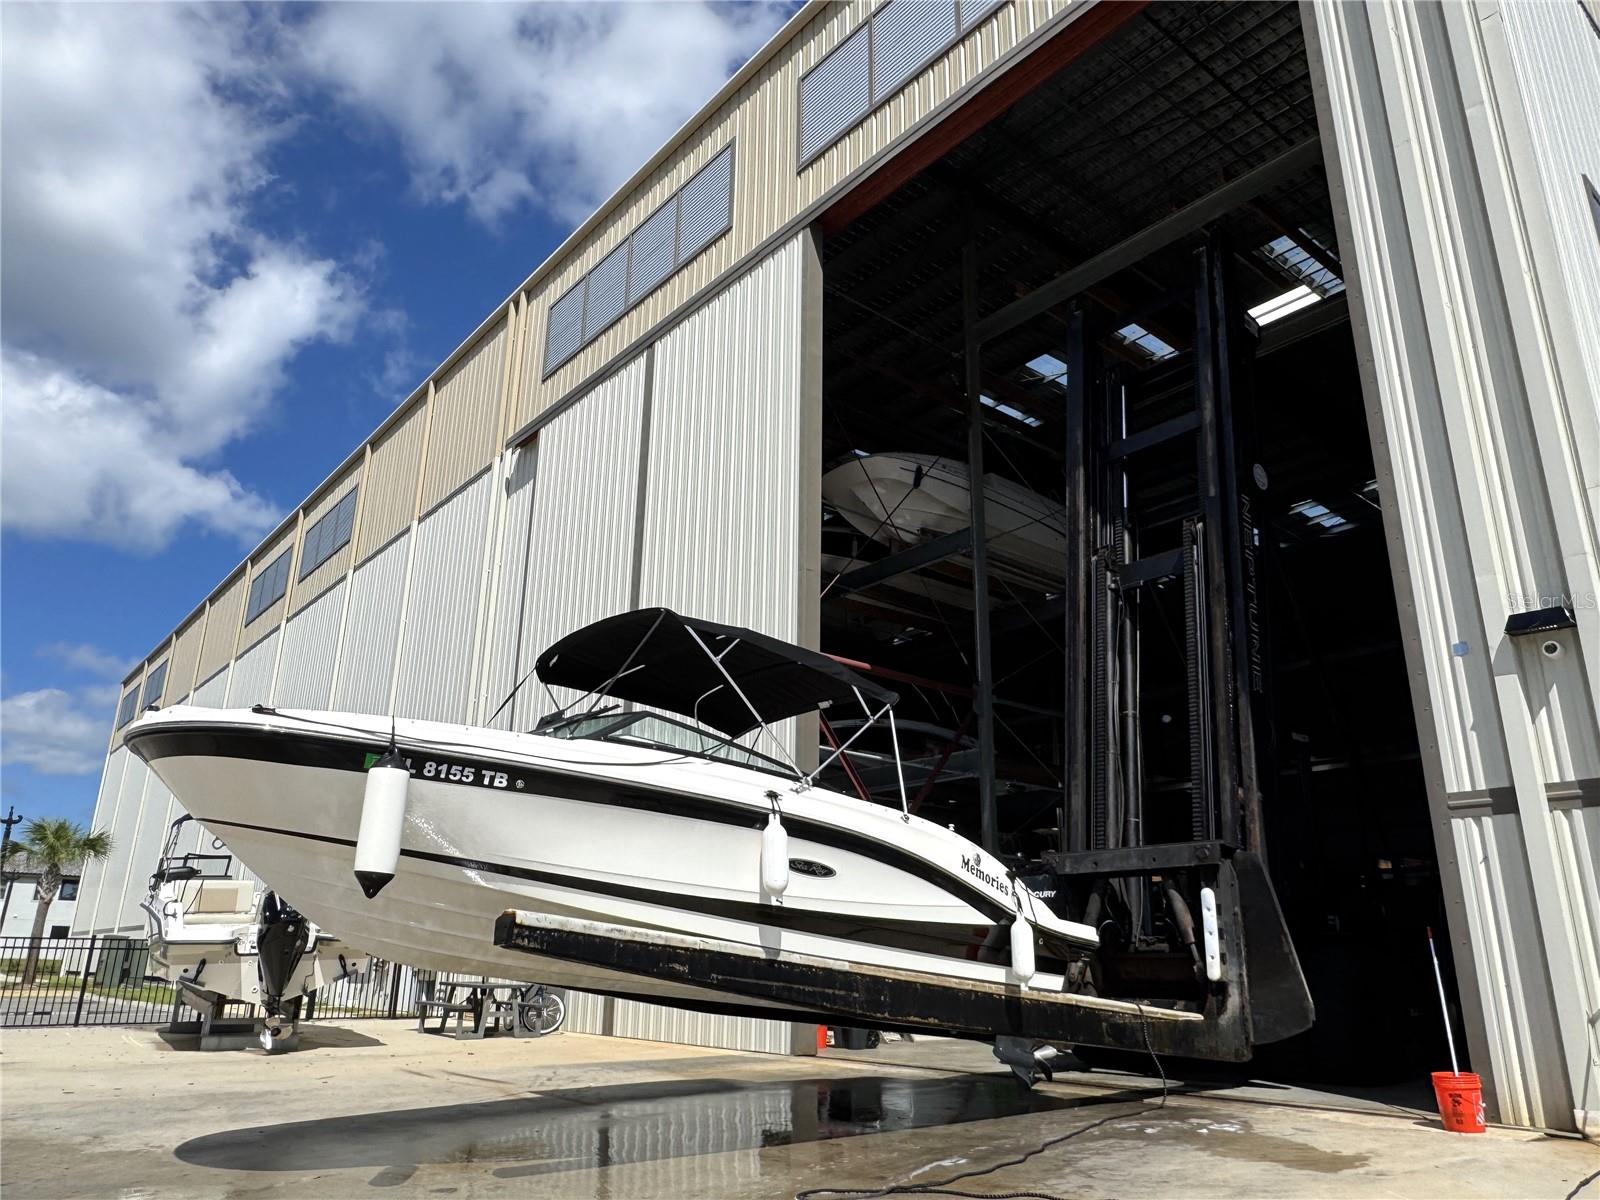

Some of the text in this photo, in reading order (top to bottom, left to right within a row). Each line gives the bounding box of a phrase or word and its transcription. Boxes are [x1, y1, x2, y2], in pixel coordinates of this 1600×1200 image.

[422, 761, 475, 783] 8155
[481, 769, 508, 788] TB
[960, 854, 1010, 897] Memories
